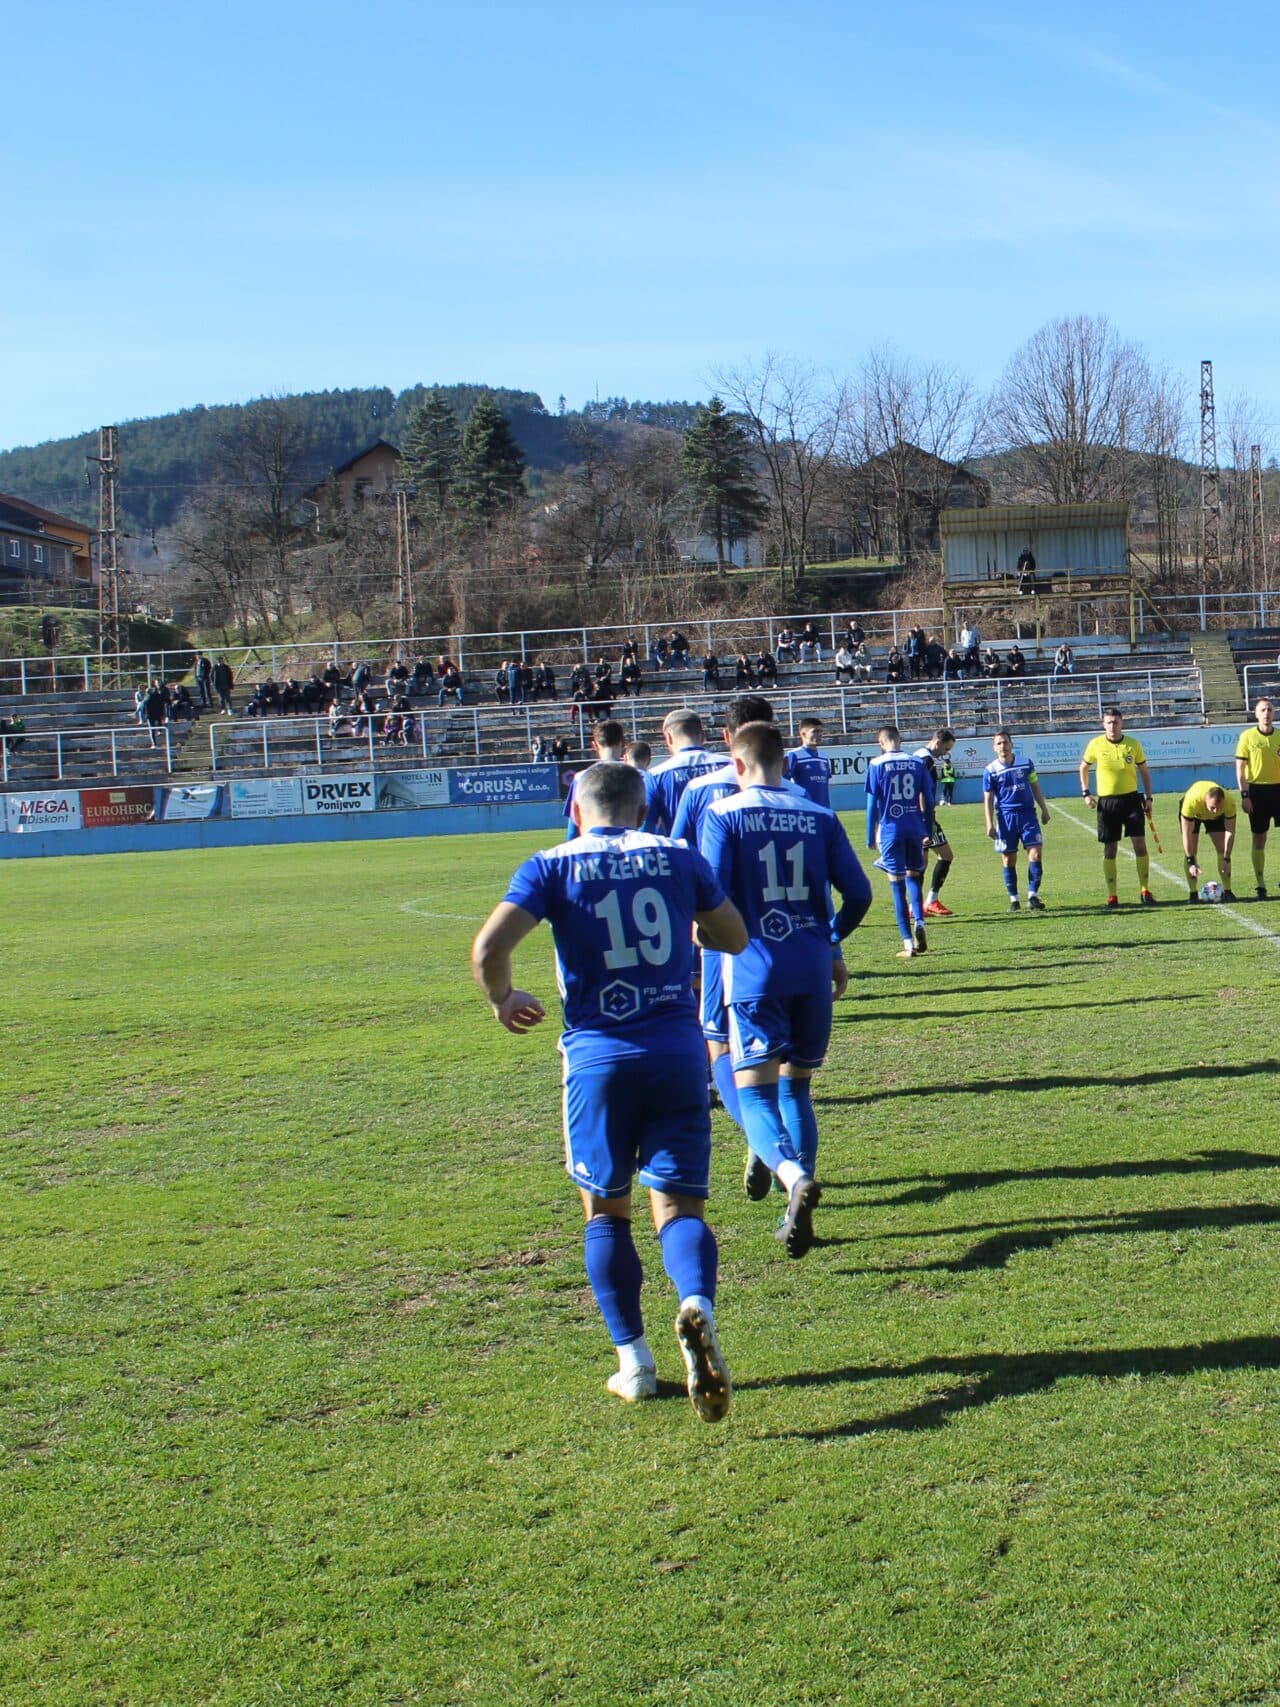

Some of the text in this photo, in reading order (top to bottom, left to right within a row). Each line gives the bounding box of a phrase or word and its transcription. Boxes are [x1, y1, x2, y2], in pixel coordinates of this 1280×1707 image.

[307, 781, 371, 800] DRVEX
[890, 773, 915, 801] 18
[19, 799, 69, 814] MEGA
[86, 803, 152, 817] EUROHERC
[316, 800, 361, 812] Ponijevo
[27, 814, 69, 825] Diskont
[743, 809, 817, 835] NK ŽEPČE
[574, 849, 672, 884] NK ŽEPČE
[758, 840, 810, 902] 11
[594, 887, 673, 970] 19
